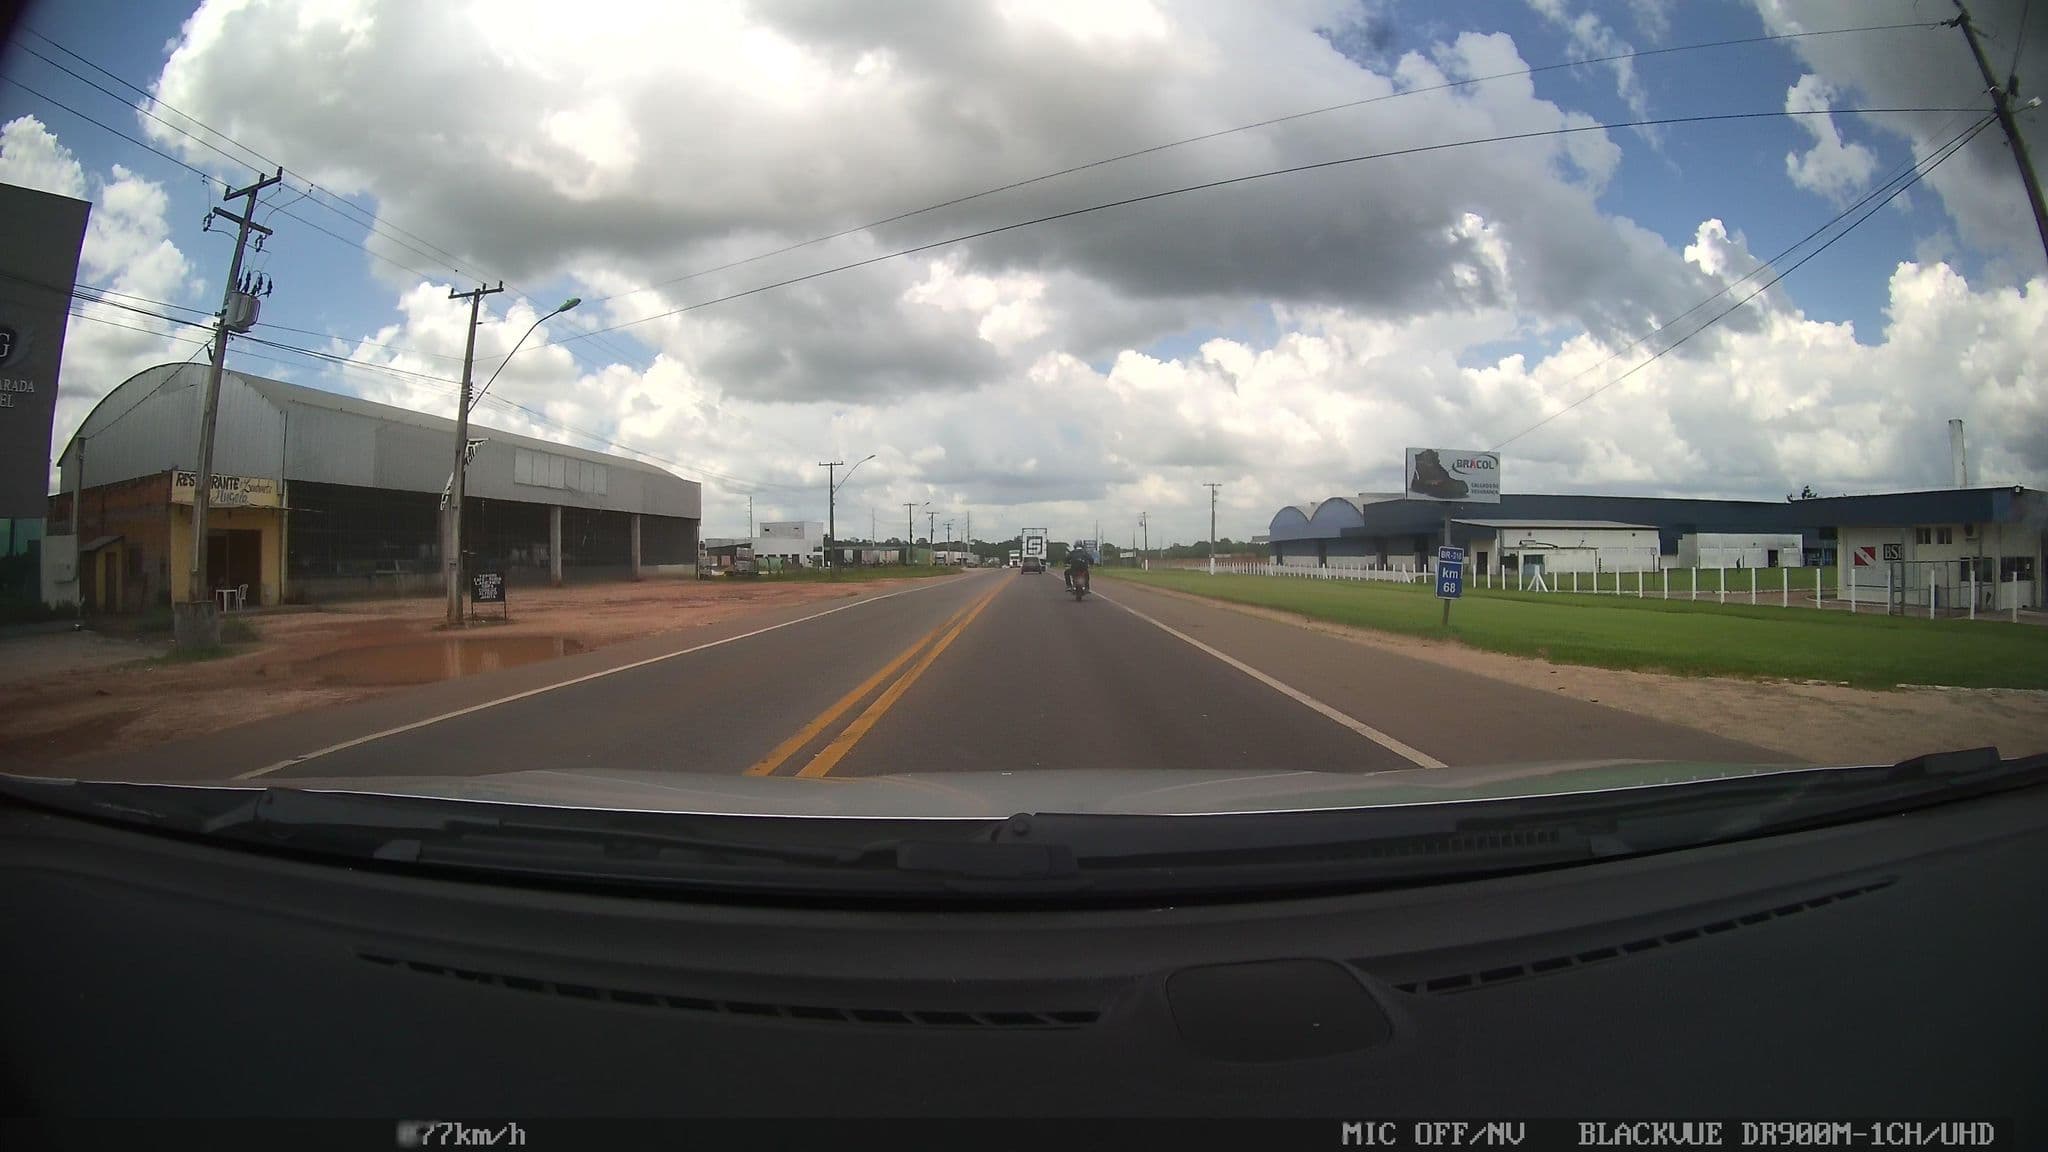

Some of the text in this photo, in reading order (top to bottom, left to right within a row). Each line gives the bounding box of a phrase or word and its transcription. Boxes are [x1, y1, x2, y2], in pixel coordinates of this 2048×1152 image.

[1456, 459, 1494, 469] BRACOL
[1442, 567, 1458, 579] km
[1443, 582, 1456, 592] 68
